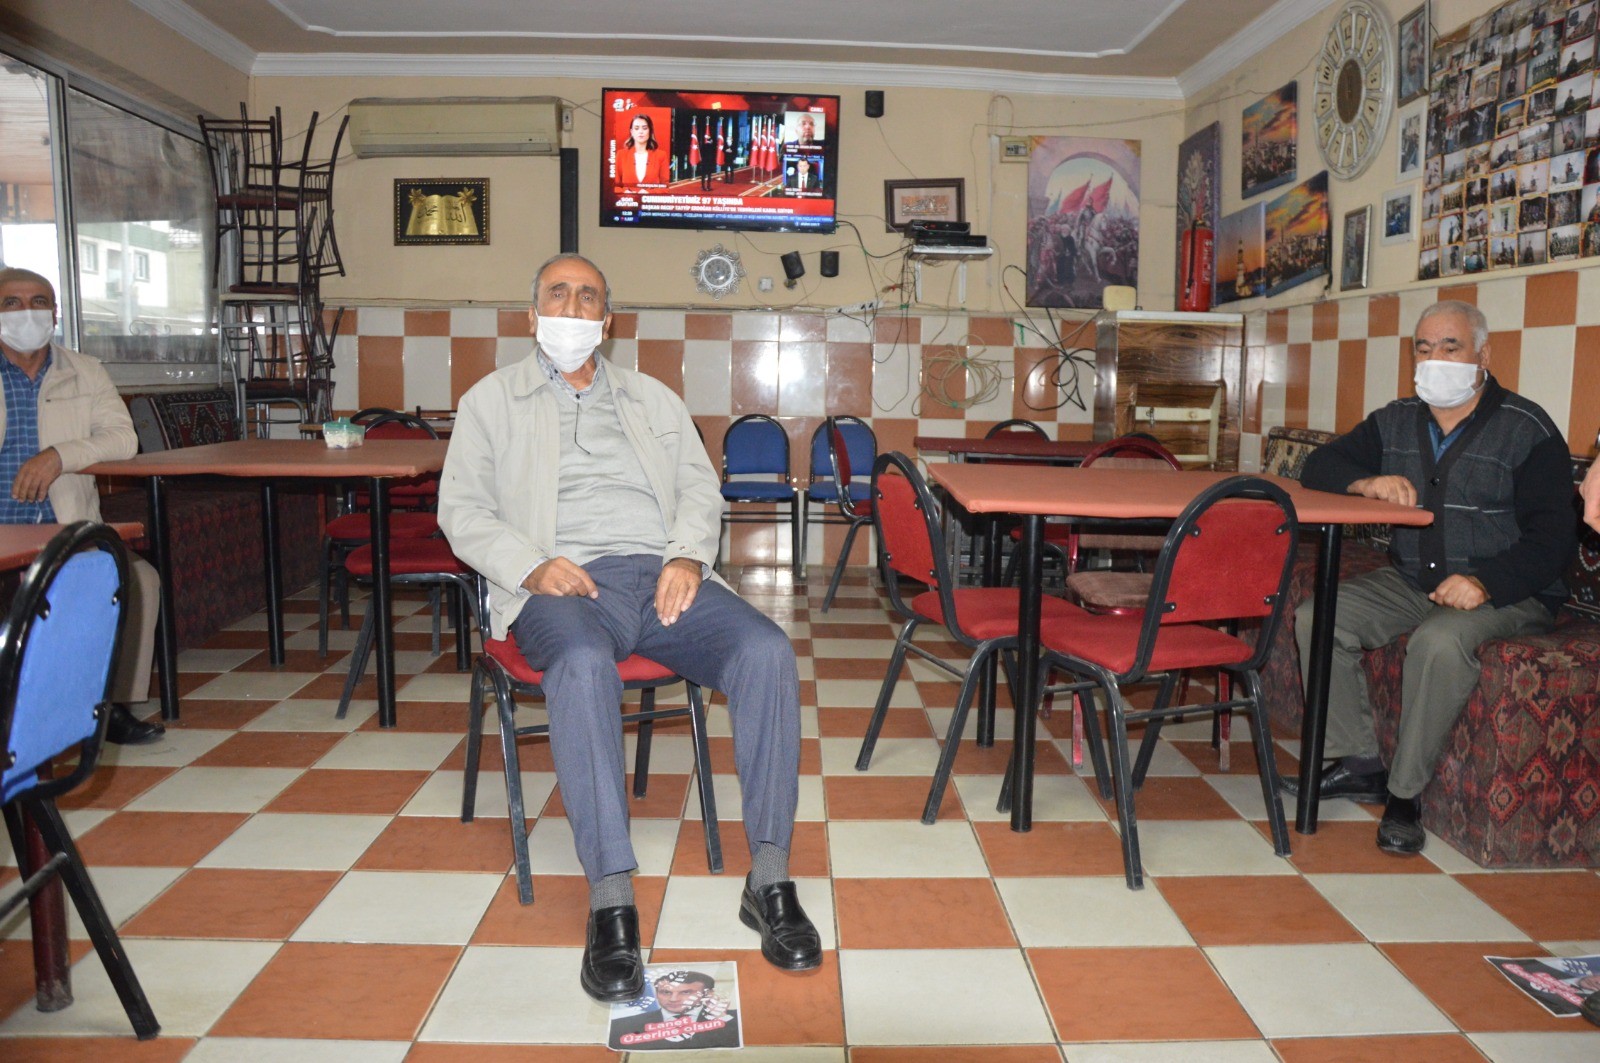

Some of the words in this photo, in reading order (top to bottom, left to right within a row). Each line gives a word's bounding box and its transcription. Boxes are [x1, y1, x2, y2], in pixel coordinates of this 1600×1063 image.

[608, 139, 616, 163] durum
[623, 1028, 679, 1043] Üzerine
[684, 1020, 722, 1032] olsun
[648, 1018, 688, 1030] Lanet
